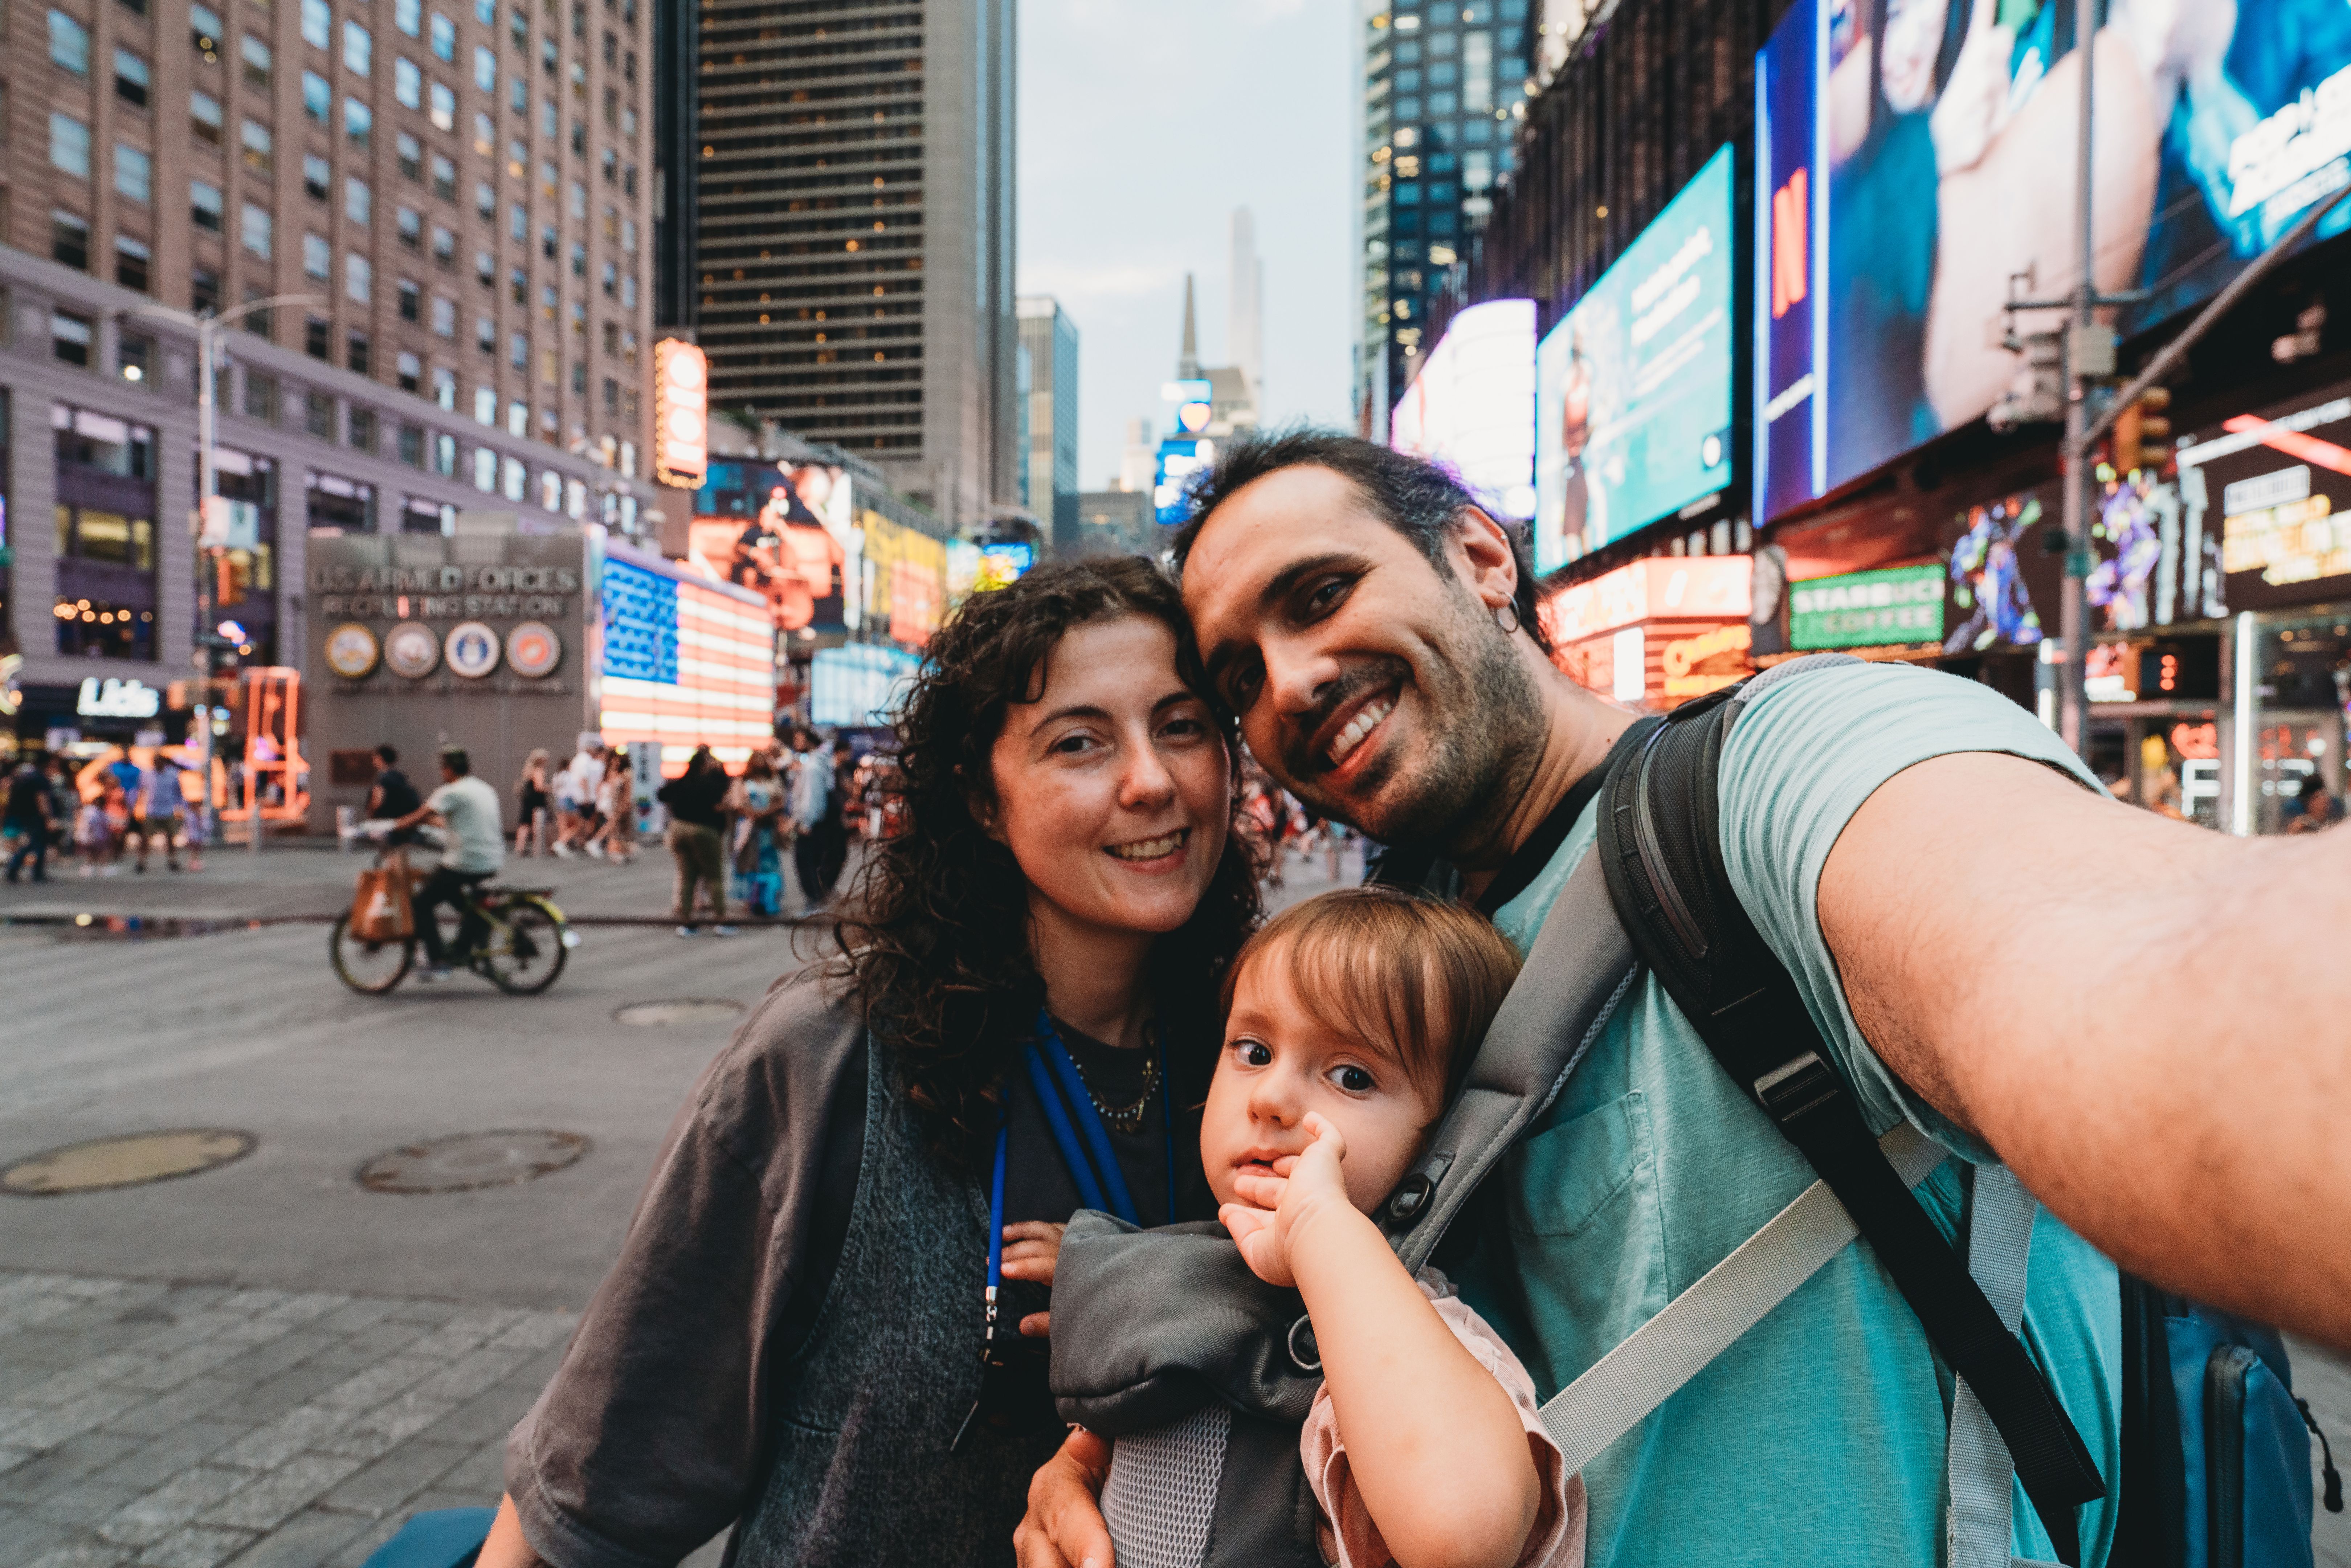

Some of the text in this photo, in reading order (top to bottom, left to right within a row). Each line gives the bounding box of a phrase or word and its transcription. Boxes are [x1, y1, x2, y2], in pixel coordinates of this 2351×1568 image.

[356, 565, 464, 593] ARMED
[466, 565, 578, 594] FORCES
[464, 595, 565, 619] STATION
[1824, 605, 1934, 633] COFFEE
